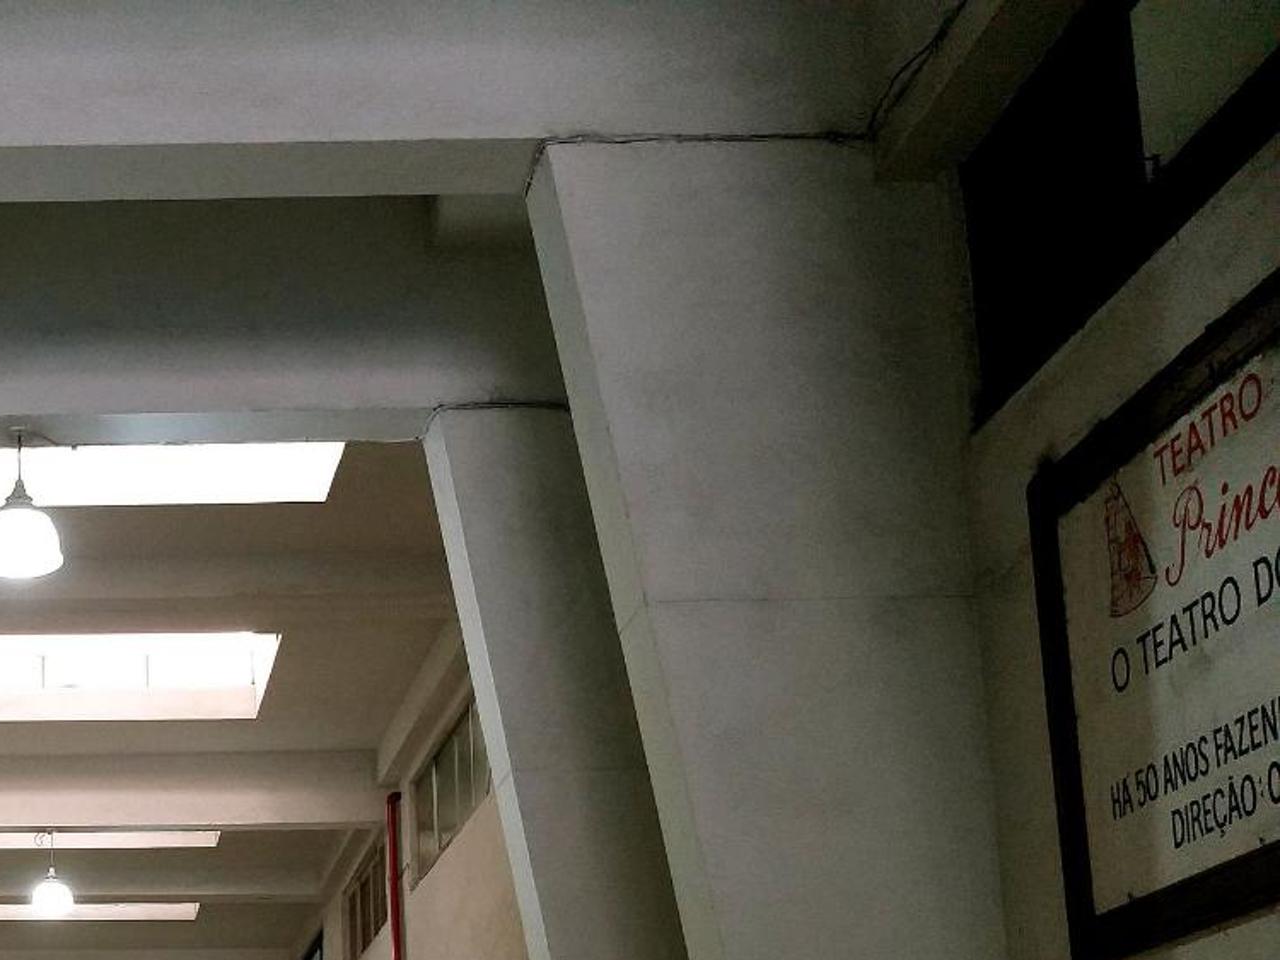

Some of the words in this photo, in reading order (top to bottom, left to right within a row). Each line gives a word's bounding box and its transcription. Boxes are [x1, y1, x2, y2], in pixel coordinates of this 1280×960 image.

[1153, 373, 1262, 487] TEATRO
[1163, 463, 1280, 588] Princ
[1111, 646, 1132, 694] O
[1136, 575, 1242, 676] TEATRO
[1253, 546, 1280, 607] D
[1110, 772, 1134, 821] HÁ
[1134, 762, 1159, 809] 50
[1163, 734, 1210, 797] ANOS
[1213, 695, 1280, 768] FAZEN
